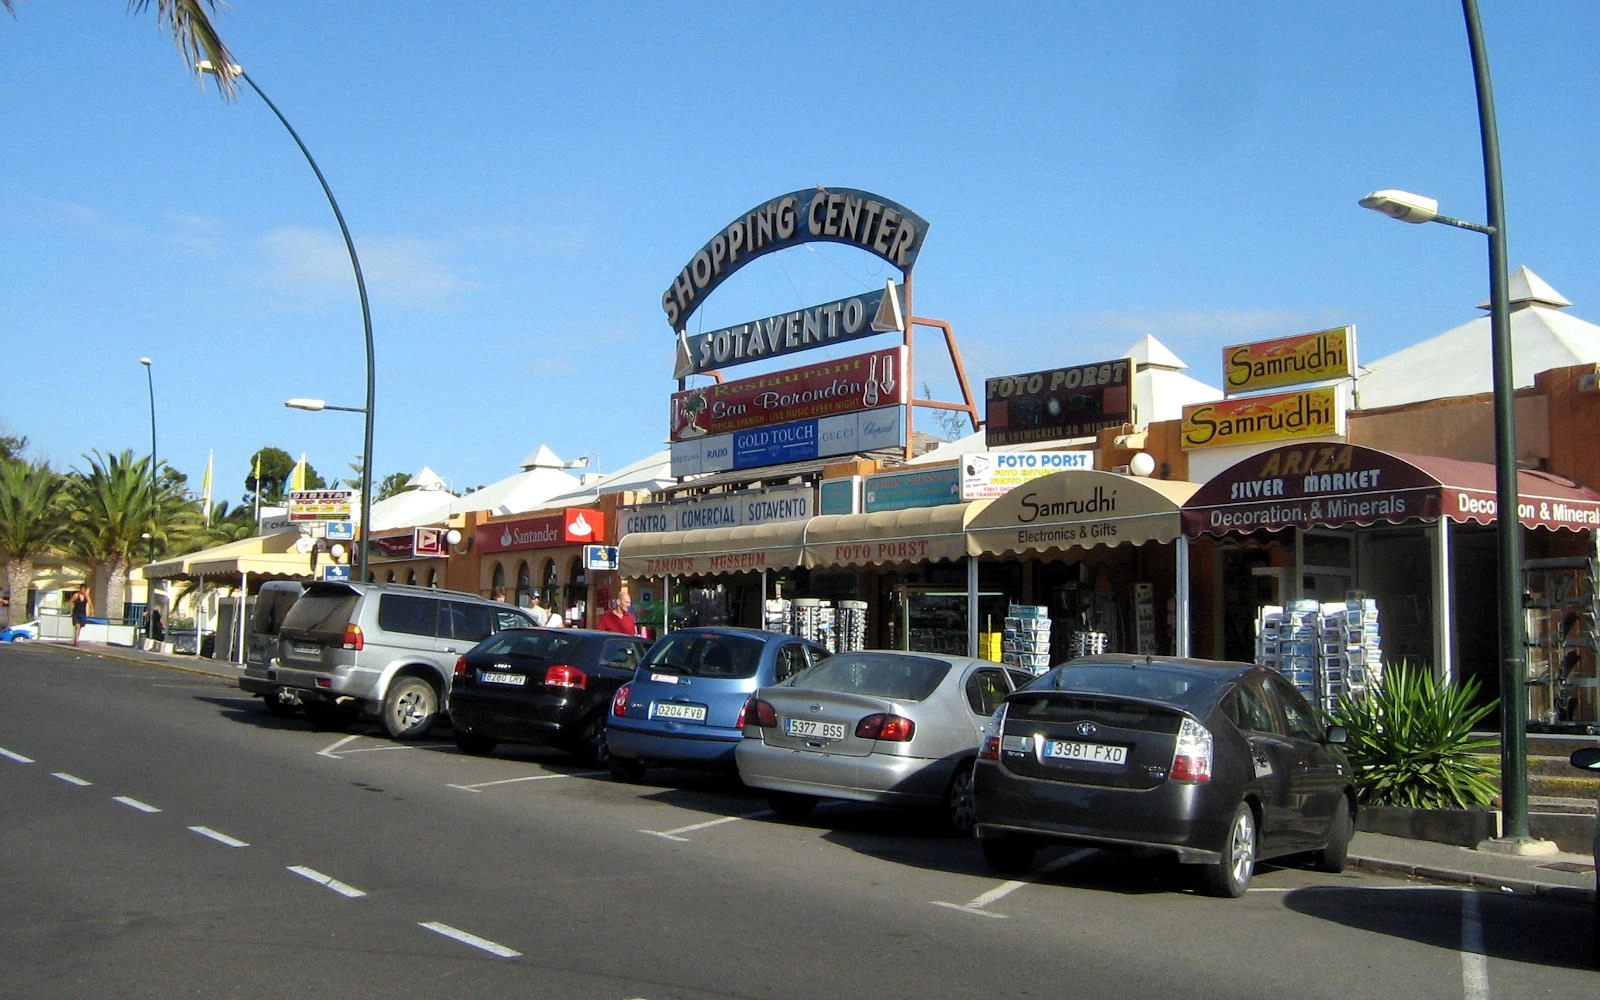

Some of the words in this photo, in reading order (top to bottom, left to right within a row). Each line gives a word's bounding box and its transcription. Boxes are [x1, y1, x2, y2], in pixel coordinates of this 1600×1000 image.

[661, 196, 797, 326] SHOPPING
[807, 192, 916, 267] CENTER
[699, 297, 866, 367] SOTAVENTO
[1228, 335, 1343, 386] Samrudhi
[713, 357, 863, 398] Restaurant
[988, 376, 1043, 400] FOTO
[1050, 362, 1128, 391] PORST
[710, 401, 748, 419] San
[753, 379, 861, 409] Borondón
[768, 411, 783, 421] LIVE
[785, 407, 808, 418] MUSIC
[811, 402, 832, 414] EVERY
[834, 398, 860, 409] NIGHT
[1186, 393, 1330, 445] Samrudhi
[737, 431, 769, 449] GOLD
[772, 425, 813, 445] TOUCH
[706, 447, 728, 459] RADO
[997, 455, 1037, 468] FOTO
[1041, 454, 1087, 468] PORST
[1260, 446, 1353, 478] ARIZA
[1231, 478, 1284, 499] SILVER
[1304, 469, 1381, 493] MARKET
[627, 514, 667, 532] CENTRO
[682, 506, 736, 528] COMERCIAL
[748, 497, 807, 521] SOTAVENTO
[1017, 486, 1118, 523] Samrudhi
[1211, 505, 1301, 527] Decoration
[1310, 499, 1323, 519] &
[1328, 495, 1406, 518] Minerals
[1458, 493, 1534, 519] Decoon
[1540, 502, 1551, 521] &
[513, 524, 559, 544] Santander
[1018, 529, 1076, 544] Electronics
[1079, 527, 1088, 538] &
[1091, 523, 1117, 538] Gifts
[836, 543, 871, 560] FOTO
[878, 540, 929, 558] PORST
[658, 705, 682, 717] 0204
[791, 719, 817, 735] 5377
[822, 723, 842, 738] BSS
[1054, 742, 1088, 759] 3981
[1094, 745, 1122, 762] FXD
